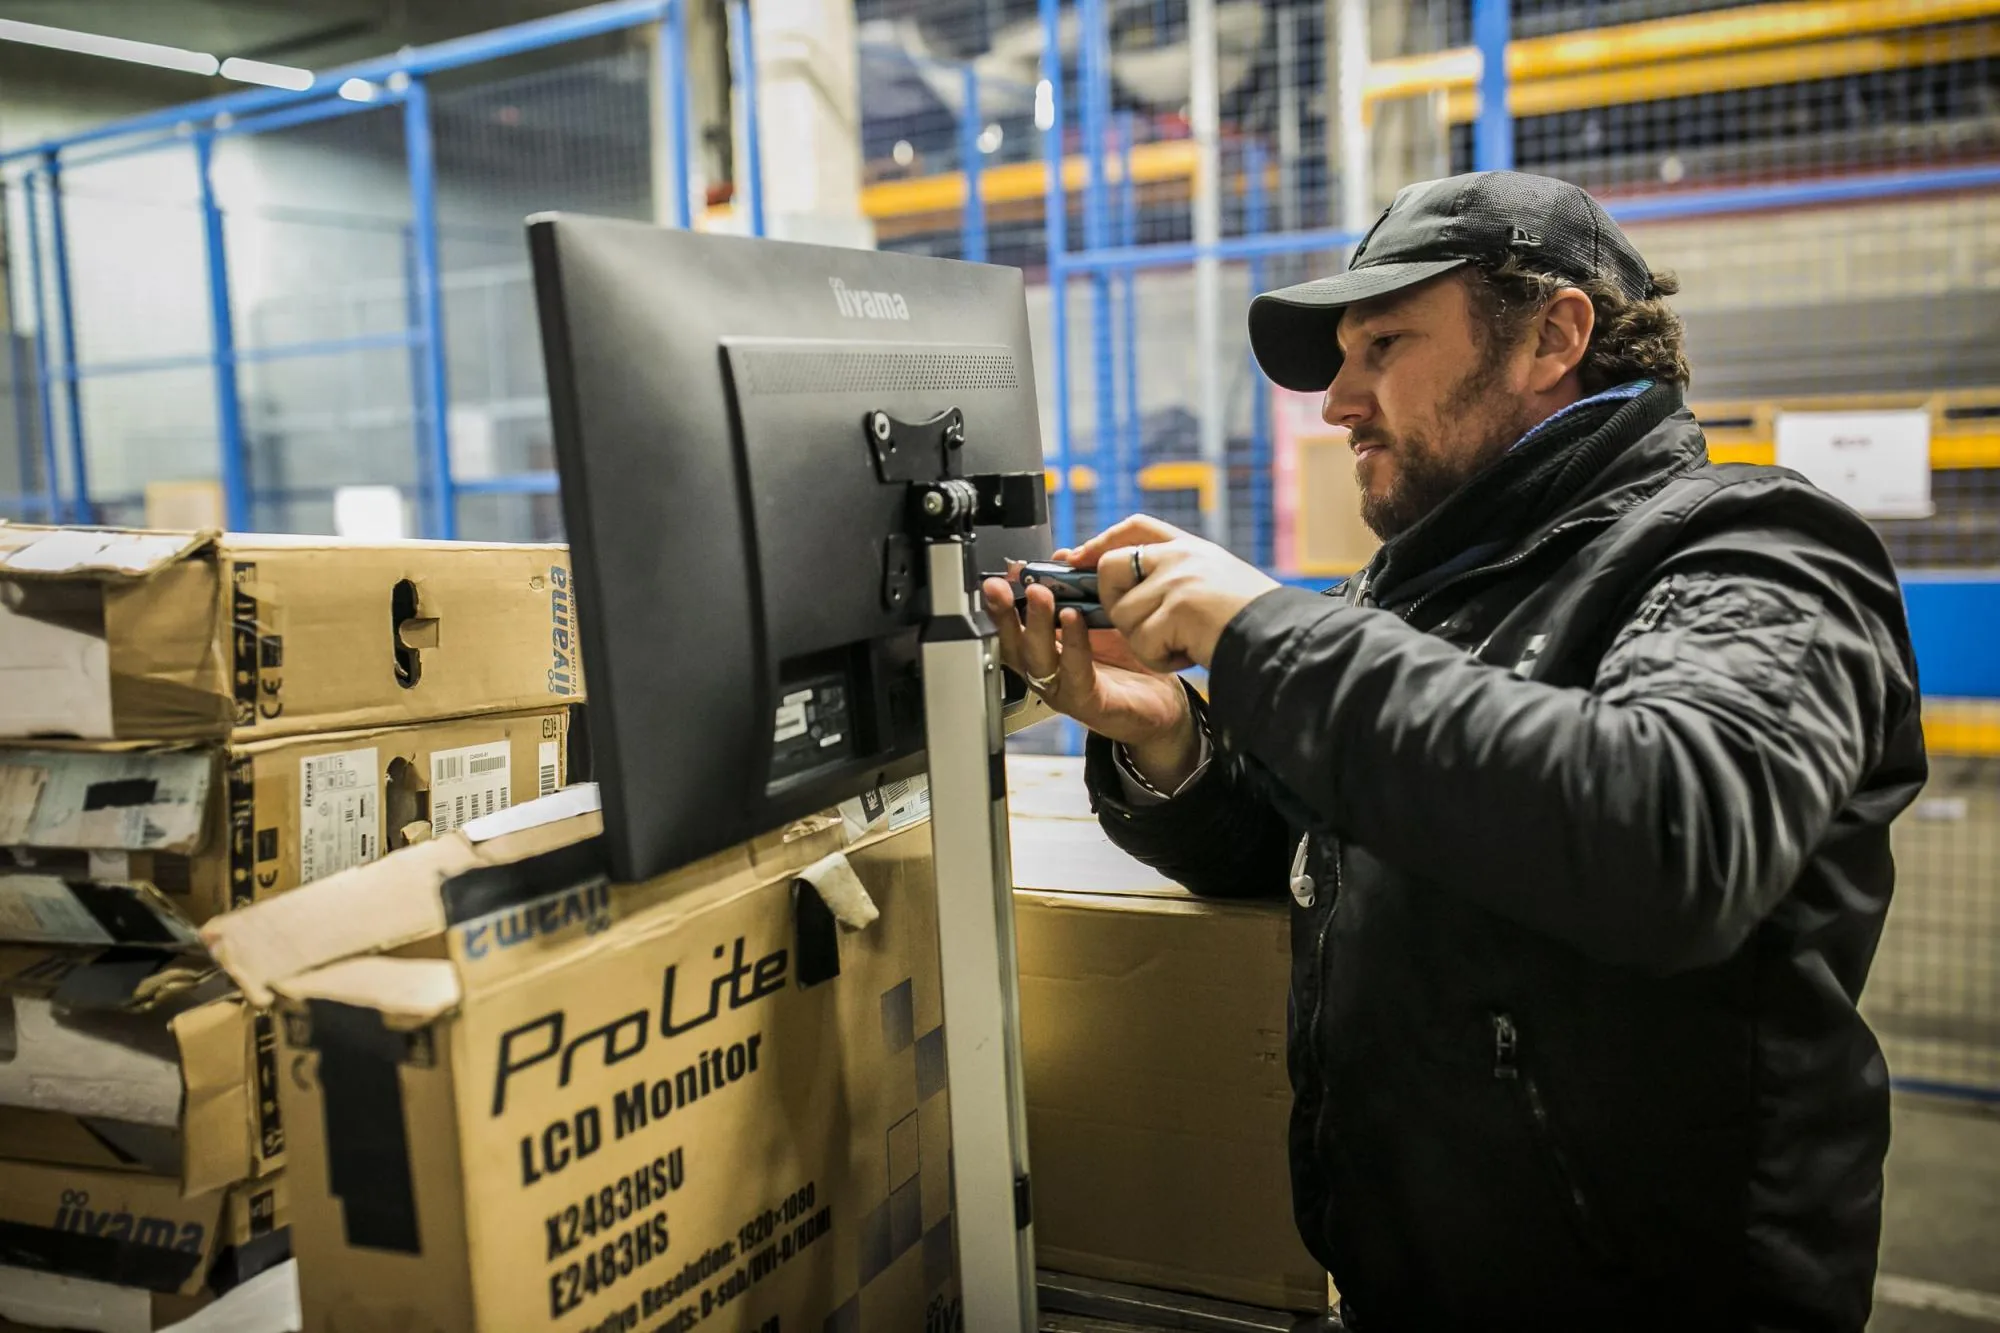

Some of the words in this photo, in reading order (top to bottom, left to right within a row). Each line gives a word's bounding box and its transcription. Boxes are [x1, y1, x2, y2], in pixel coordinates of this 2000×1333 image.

[828, 276, 910, 320] iiyama
[548, 565, 571, 696] iiyama
[490, 936, 789, 1119] ProLite
[520, 1106, 602, 1188] LCD
[612, 1031, 762, 1142] Monitor
[54, 1188, 205, 1255] iiyama
[549, 1211, 670, 1320] E2483HS
[641, 1240, 736, 1320] Resolution:
